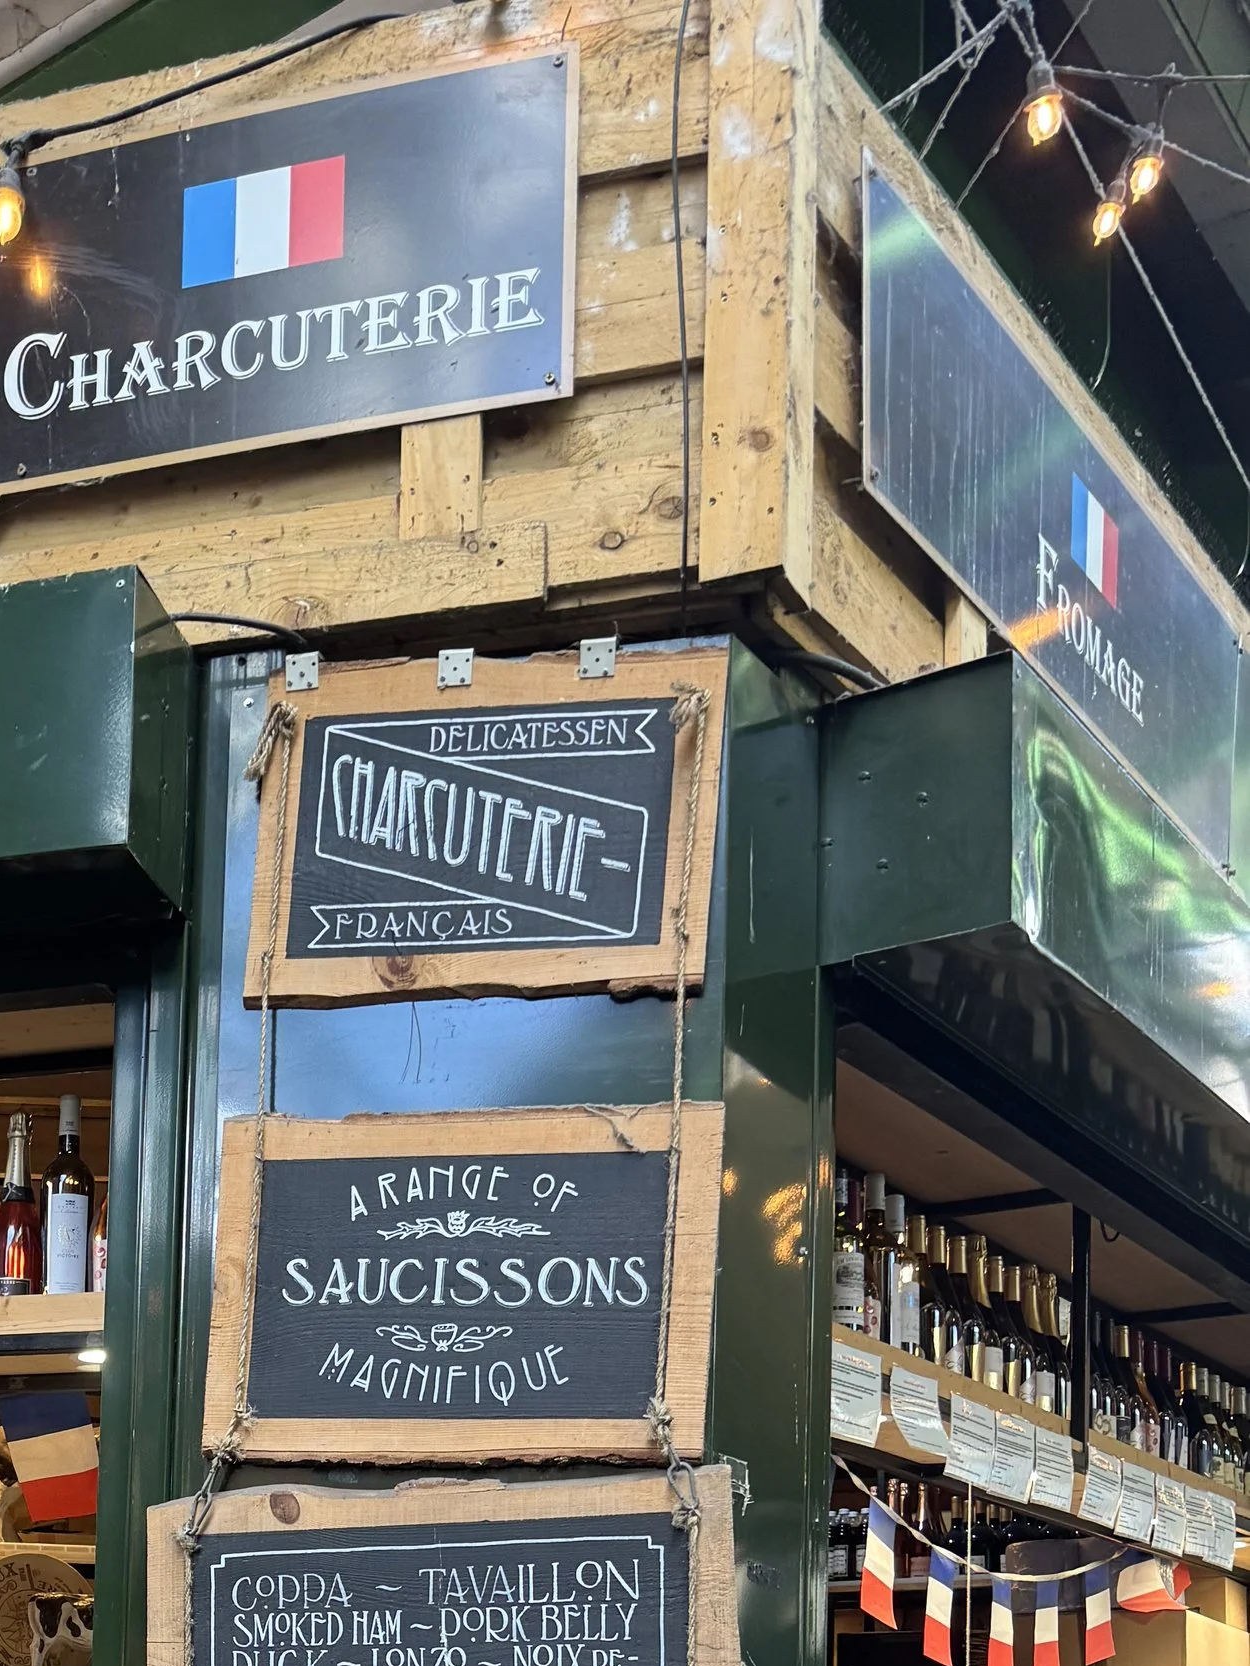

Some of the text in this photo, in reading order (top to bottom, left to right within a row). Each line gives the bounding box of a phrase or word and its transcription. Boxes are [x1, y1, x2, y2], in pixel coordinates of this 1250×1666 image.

[3, 267, 544, 420] CHARCUTERIE
[1036, 533, 1144, 727] FROMAGE
[429, 718, 628, 753] DELICATESSEN
[335, 909, 513, 941] FRANÇAIS
[351, 1165, 578, 1221] A RANGE OF
[281, 1256, 650, 1308] SAUCISSONS
[318, 1343, 570, 1406] MAGNIFIQUE
[231, 1559, 641, 1611] COPPA TAVAILLON
[232, 1603, 638, 1648] SMOKED HAM PORK BELLY
